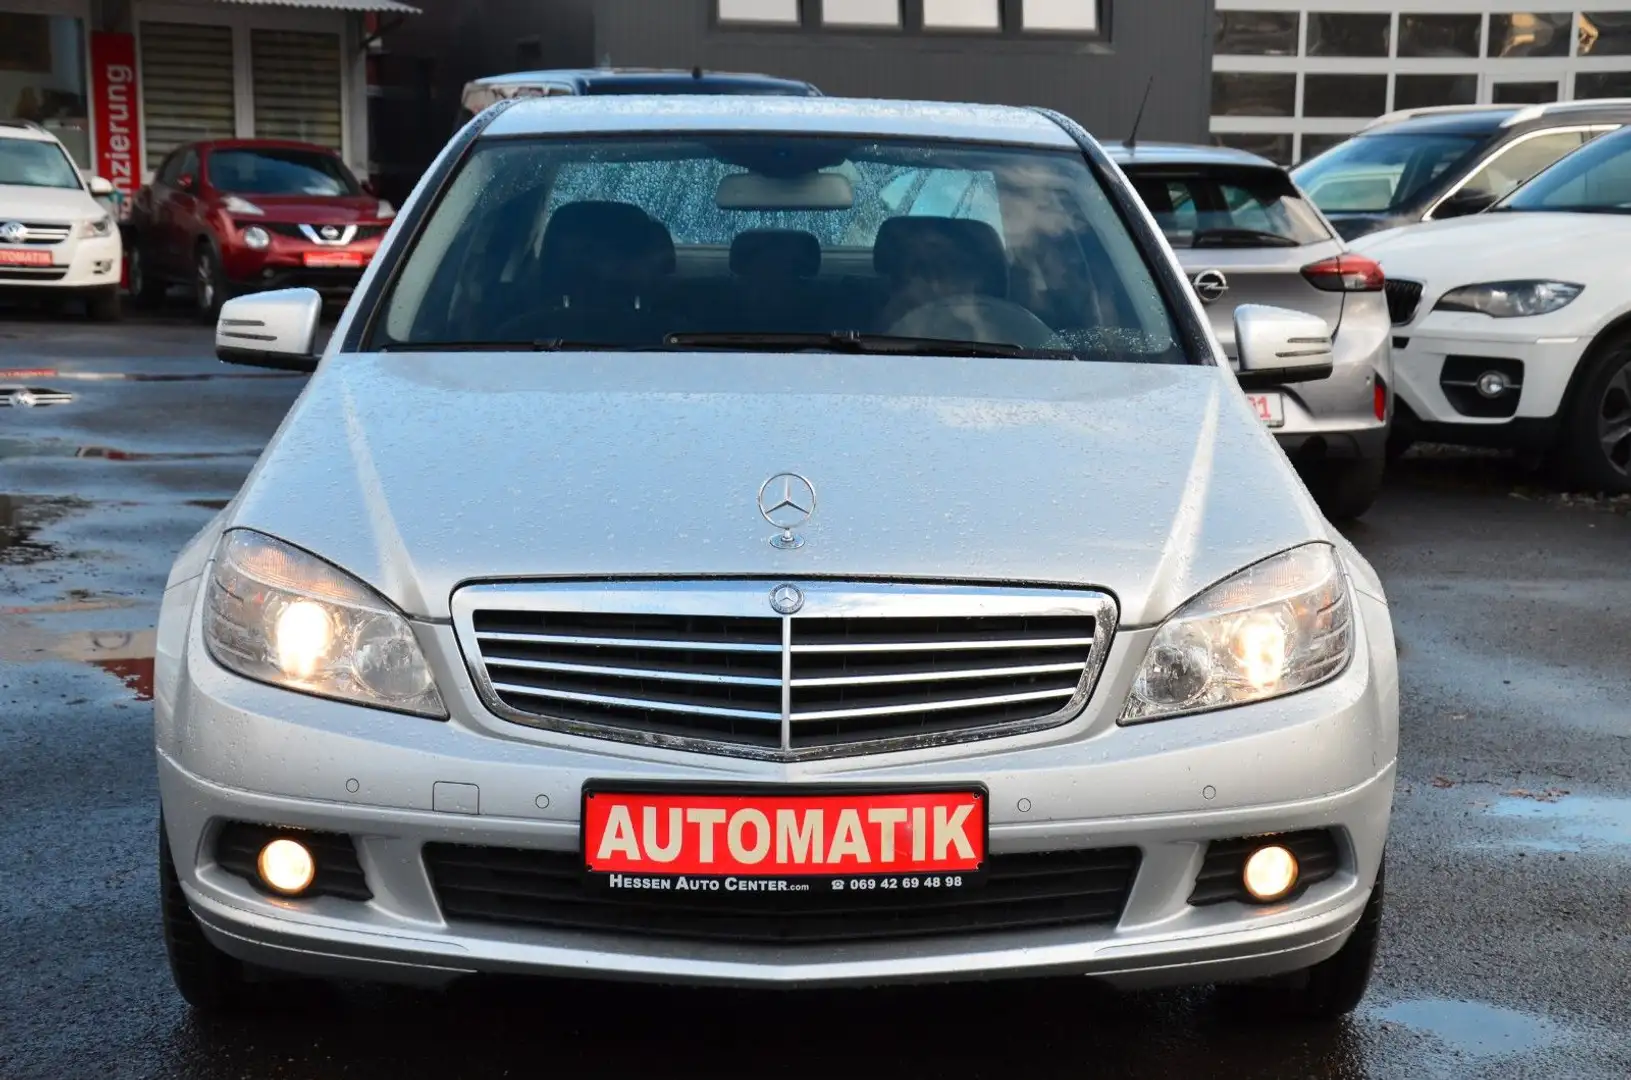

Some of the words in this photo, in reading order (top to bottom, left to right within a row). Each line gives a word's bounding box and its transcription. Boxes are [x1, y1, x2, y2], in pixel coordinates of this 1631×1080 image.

[596, 804, 977, 864] AUTOMATIK
[609, 873, 671, 890] HESSEN
[675, 876, 720, 891] AUTO
[724, 876, 809, 892] CENTER.com
[850, 879, 876, 890] 069
[880, 878, 898, 889] 42
[902, 877, 920, 889] 69
[923, 877, 941, 888] 48
[944, 876, 963, 888] 98
